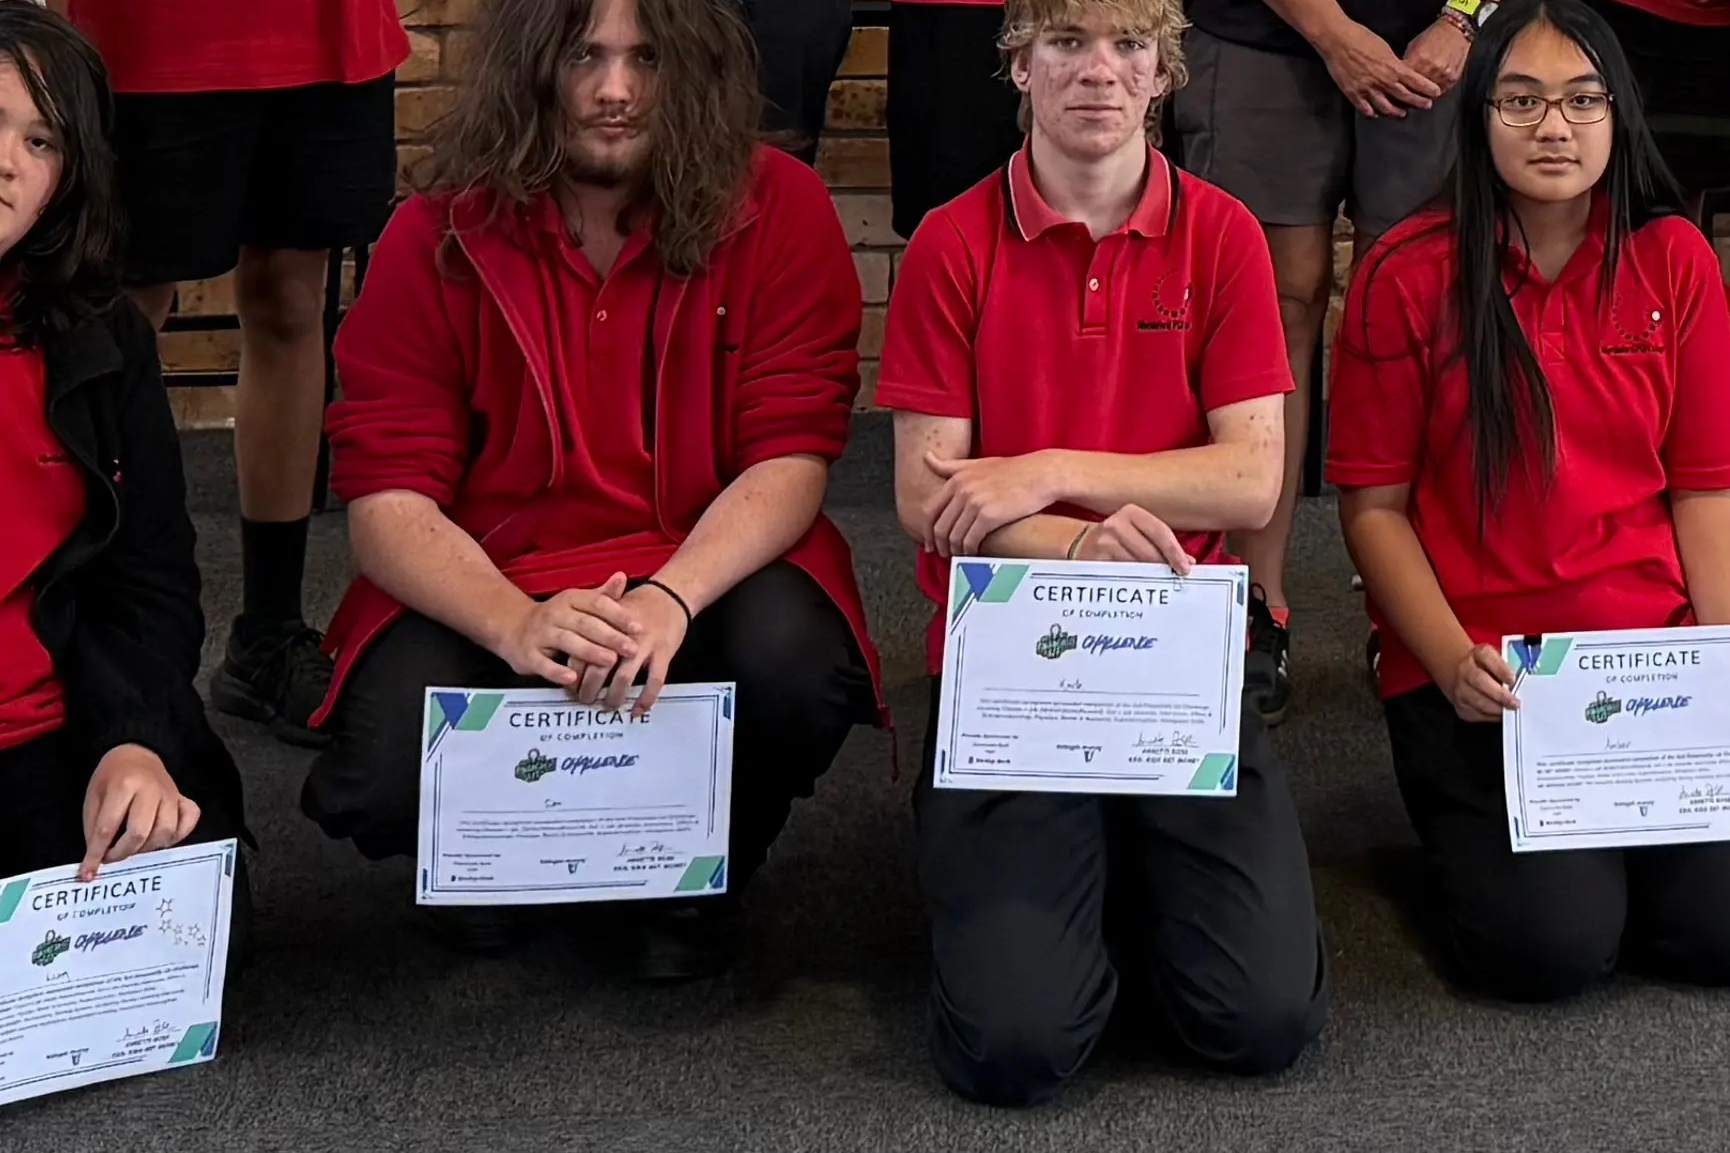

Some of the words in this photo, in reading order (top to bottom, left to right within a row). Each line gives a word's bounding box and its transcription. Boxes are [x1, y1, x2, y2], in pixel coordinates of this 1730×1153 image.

[1034, 586, 1168, 604] CERTIFICATE
[1579, 650, 1700, 670] CERTIFICATE
[509, 710, 651, 727] CERTIFICATE
[32, 876, 162, 911] CERTIFICATE
